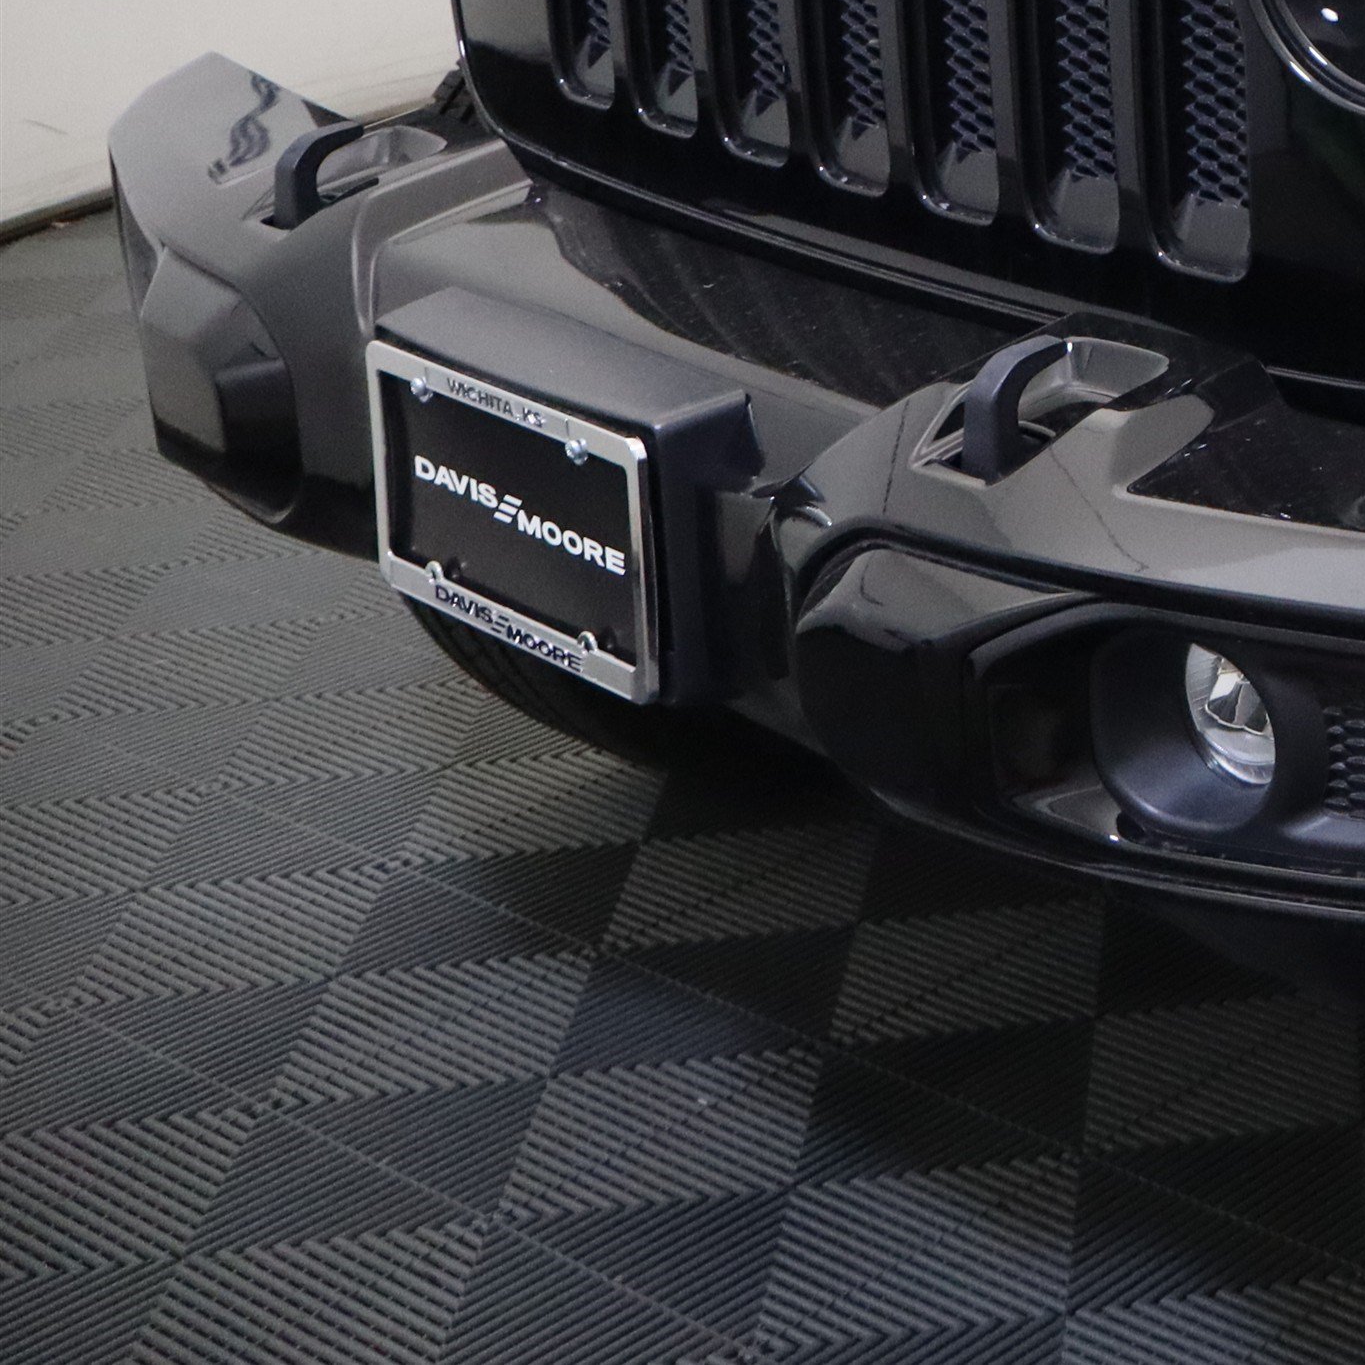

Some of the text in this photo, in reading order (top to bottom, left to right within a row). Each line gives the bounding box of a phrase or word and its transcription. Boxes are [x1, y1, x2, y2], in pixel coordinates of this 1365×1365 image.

[414, 455, 627, 576] DAVIS MOORE
[435, 585, 584, 673] DAVIS MOORE
